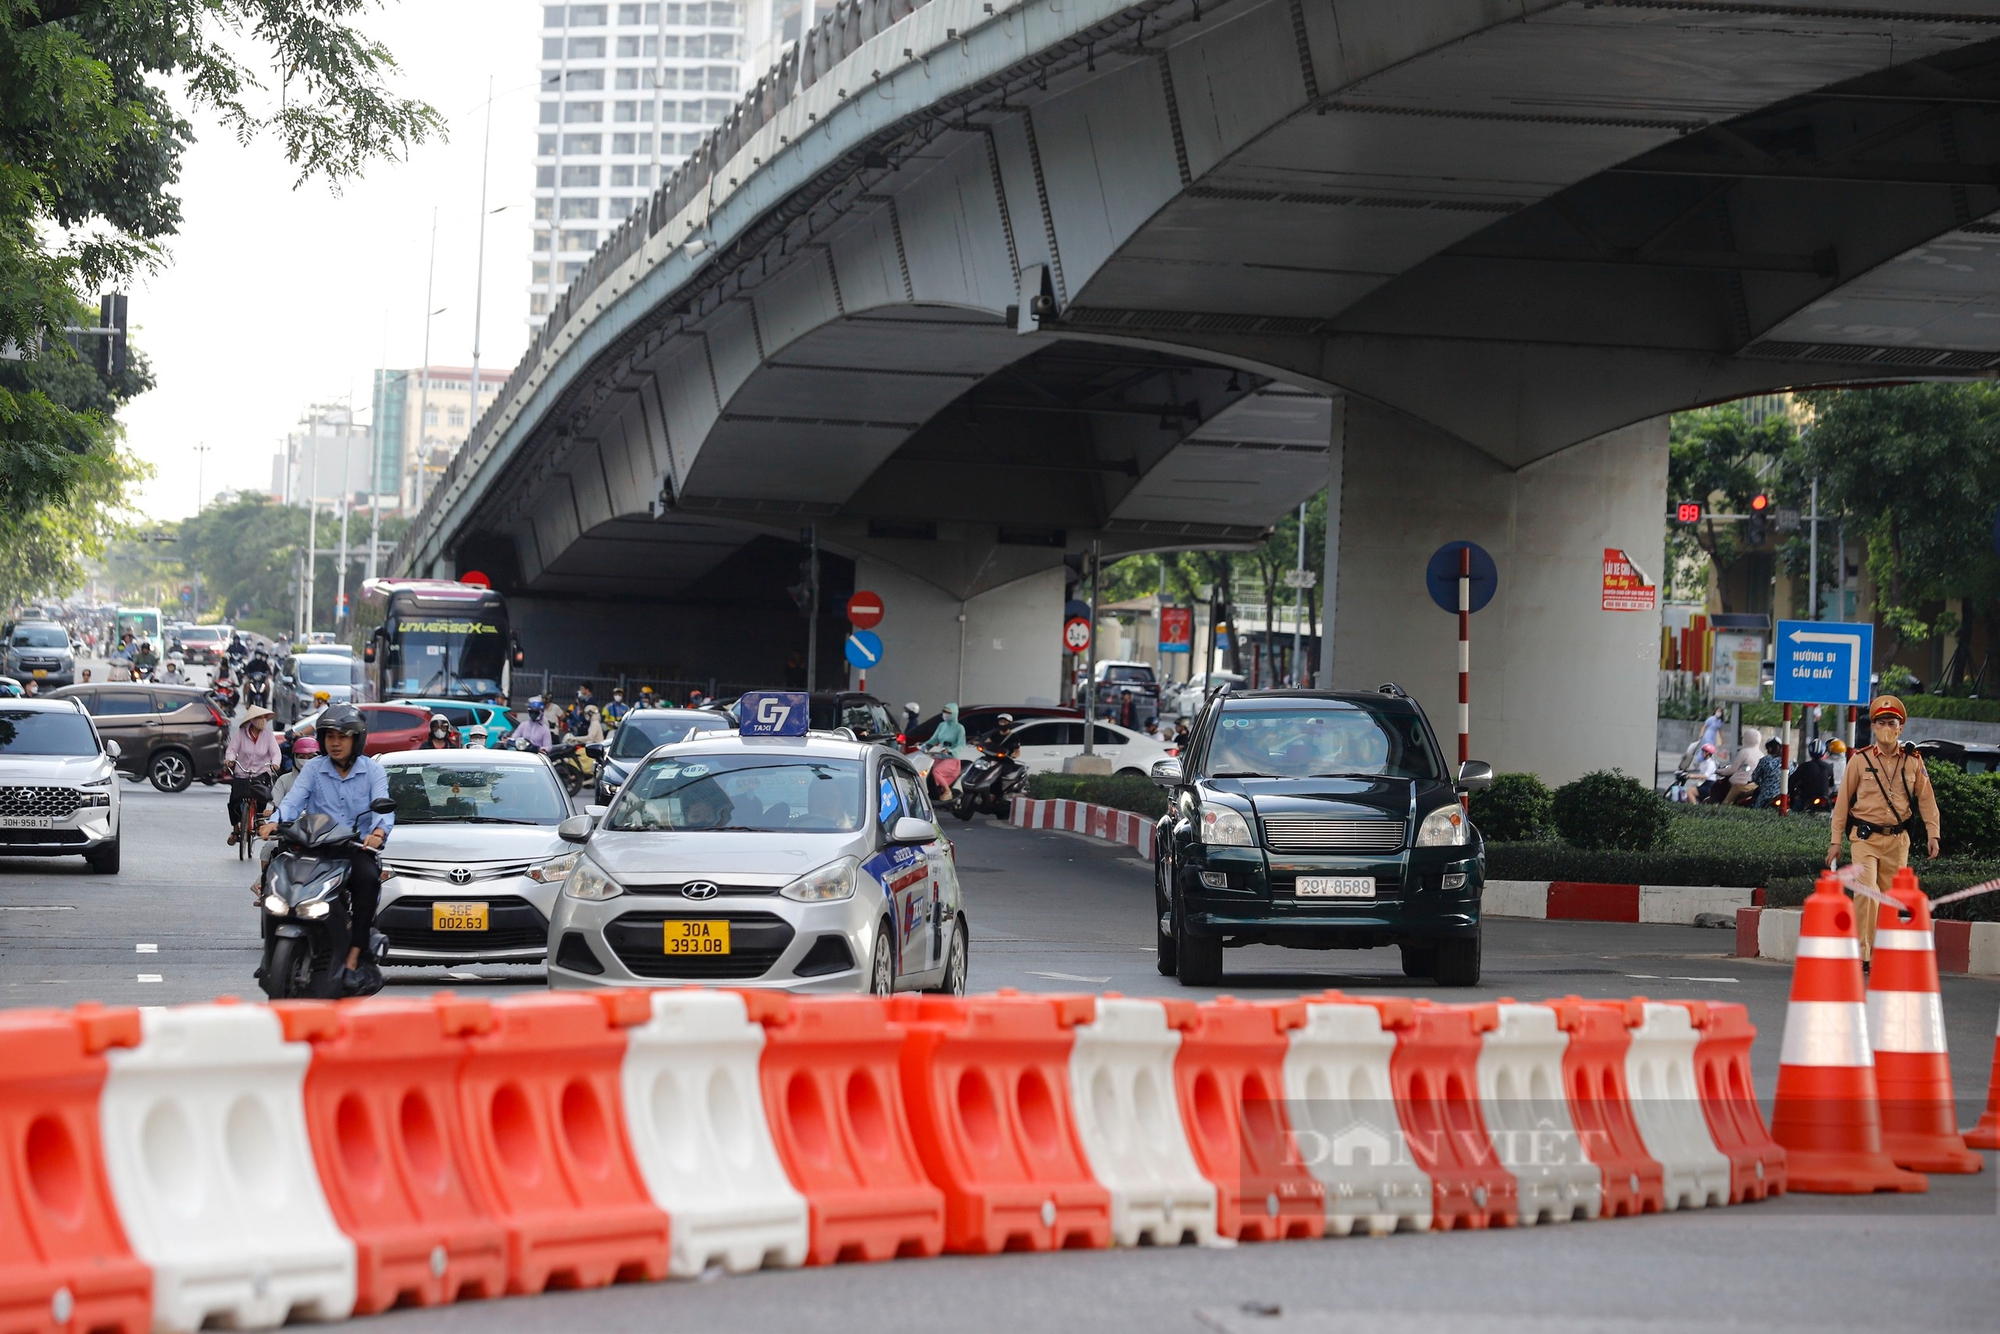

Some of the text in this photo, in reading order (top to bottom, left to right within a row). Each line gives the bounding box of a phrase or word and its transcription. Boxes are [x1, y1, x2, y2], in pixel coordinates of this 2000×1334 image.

[1678, 504, 1699, 521] 89
[1792, 648, 1837, 663] HƯỚNG ĐI
[1812, 665, 1834, 679] GIẤY
[757, 697, 791, 732] G7
[753, 724, 772, 732] TAXI
[3, 819, 48, 827] 30H-958.12
[1301, 880, 1370, 894] 29V-8589
[439, 917, 482, 929] 002.63
[682, 923, 710, 936] 30A
[671, 938, 722, 952] 393.08
